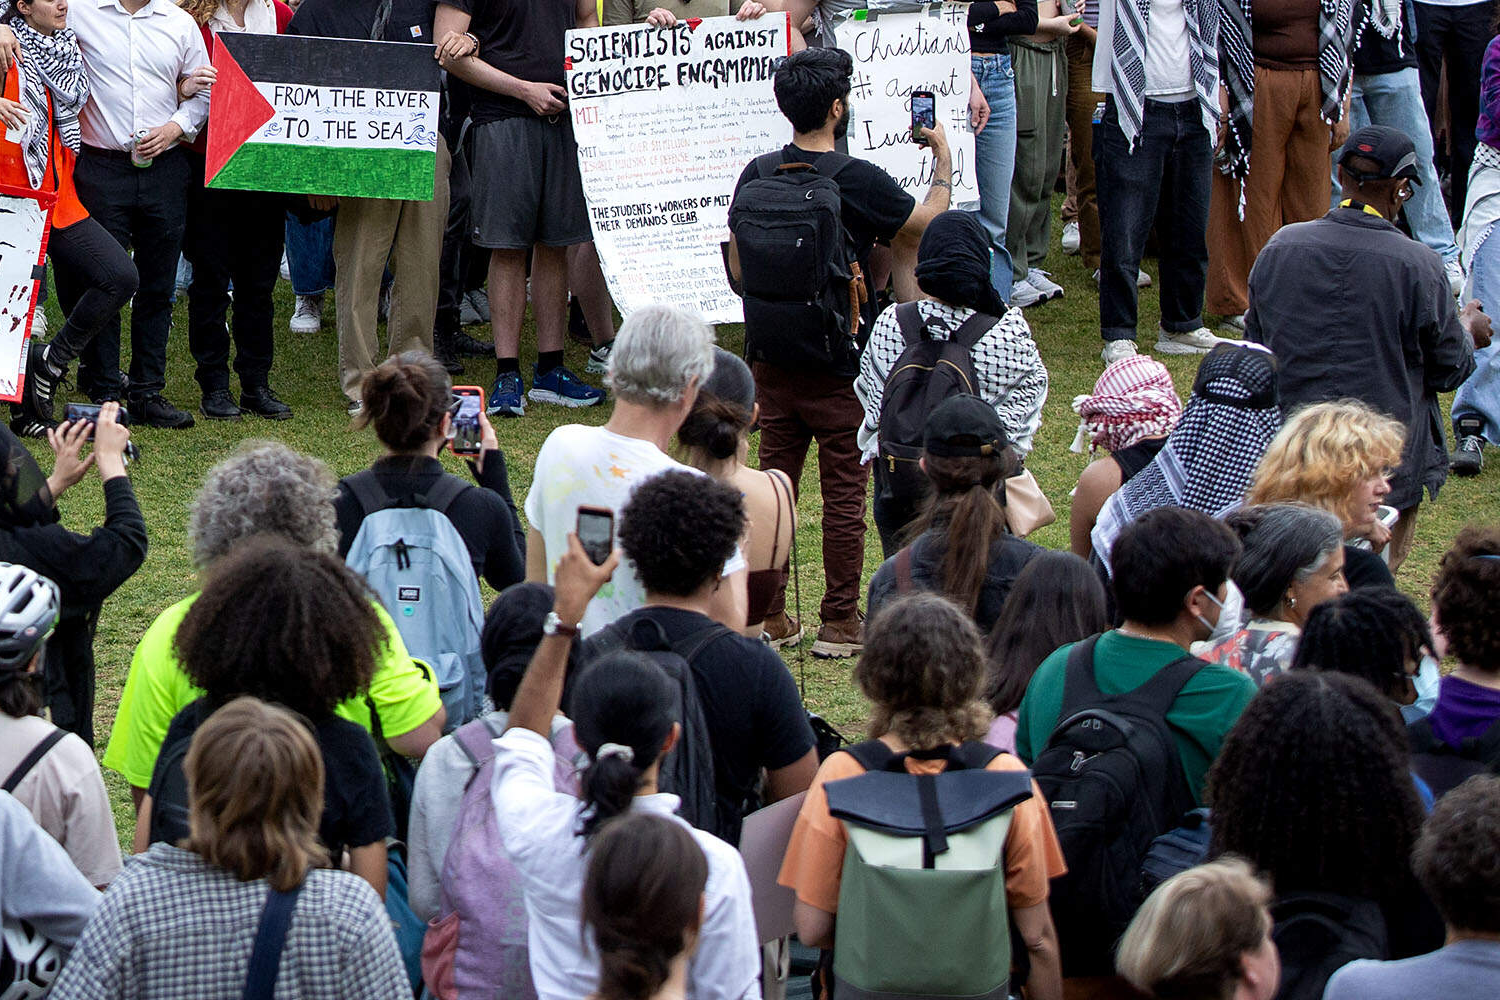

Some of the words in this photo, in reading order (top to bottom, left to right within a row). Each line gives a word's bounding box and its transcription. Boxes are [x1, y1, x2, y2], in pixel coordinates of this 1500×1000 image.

[570, 24, 692, 64] SCIENTISTS
[704, 28, 779, 51] AGAINST
[855, 22, 972, 62] Christians
[571, 64, 671, 96] GENOCIDE
[274, 85, 320, 107] FROM
[330, 89, 366, 108] THE
[376, 91, 430, 109] RIVER
[284, 117, 310, 139] TO
[323, 120, 357, 139] THE
[368, 120, 403, 140] SEA
[579, 146, 597, 158] MIT
[591, 207, 609, 219] THE
[610, 203, 652, 217] STUDENTS
[659, 198, 698, 213] WORKERS
[700, 196, 712, 208] OF
[713, 195, 730, 207] MIT
[596, 219, 621, 231] THEIR
[626, 215, 668, 230] DEMANDS
[700, 299, 718, 312] MIT
